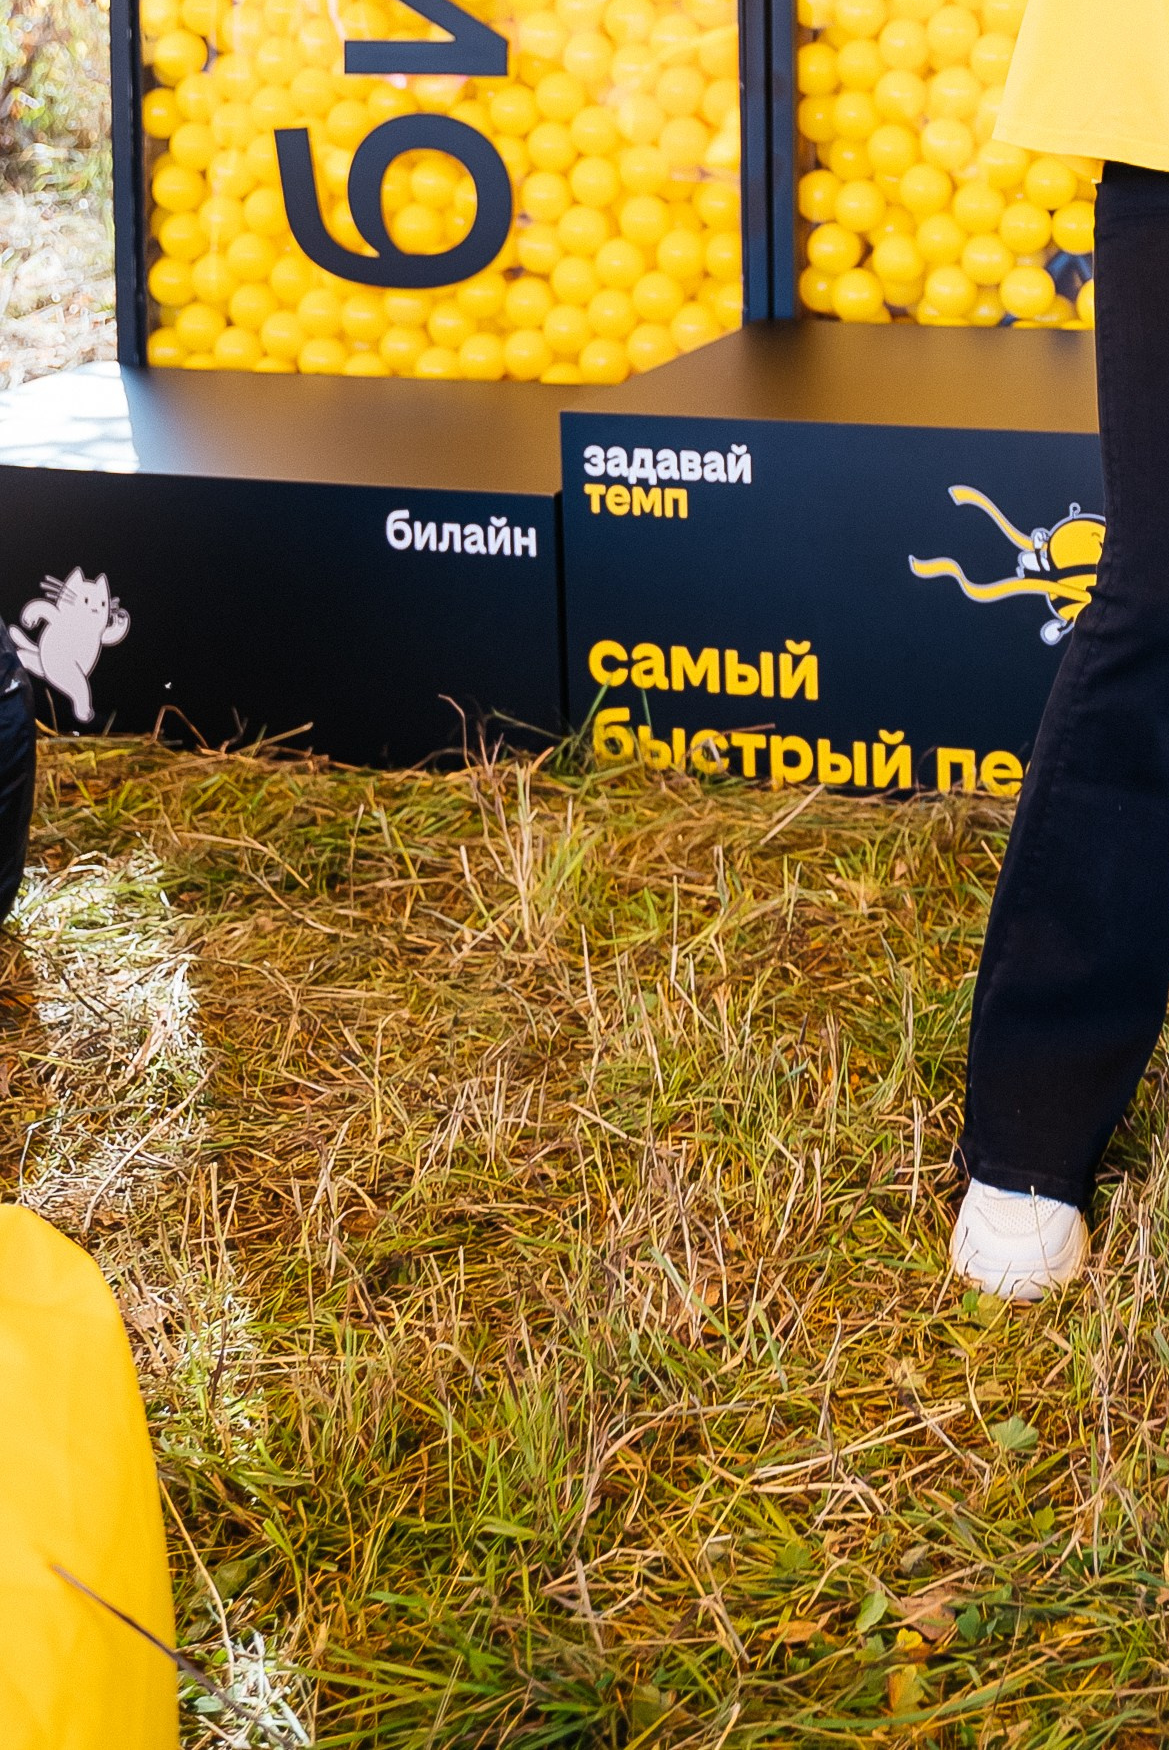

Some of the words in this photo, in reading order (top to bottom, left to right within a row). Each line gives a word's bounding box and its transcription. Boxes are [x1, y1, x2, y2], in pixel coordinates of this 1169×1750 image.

[583, 443, 752, 486] задавай
[583, 483, 688, 519] темп
[385, 508, 538, 558] билайн
[588, 639, 819, 701] самый
[593, 706, 912, 791] быстрый
[936, 746, 1033, 797] пе
